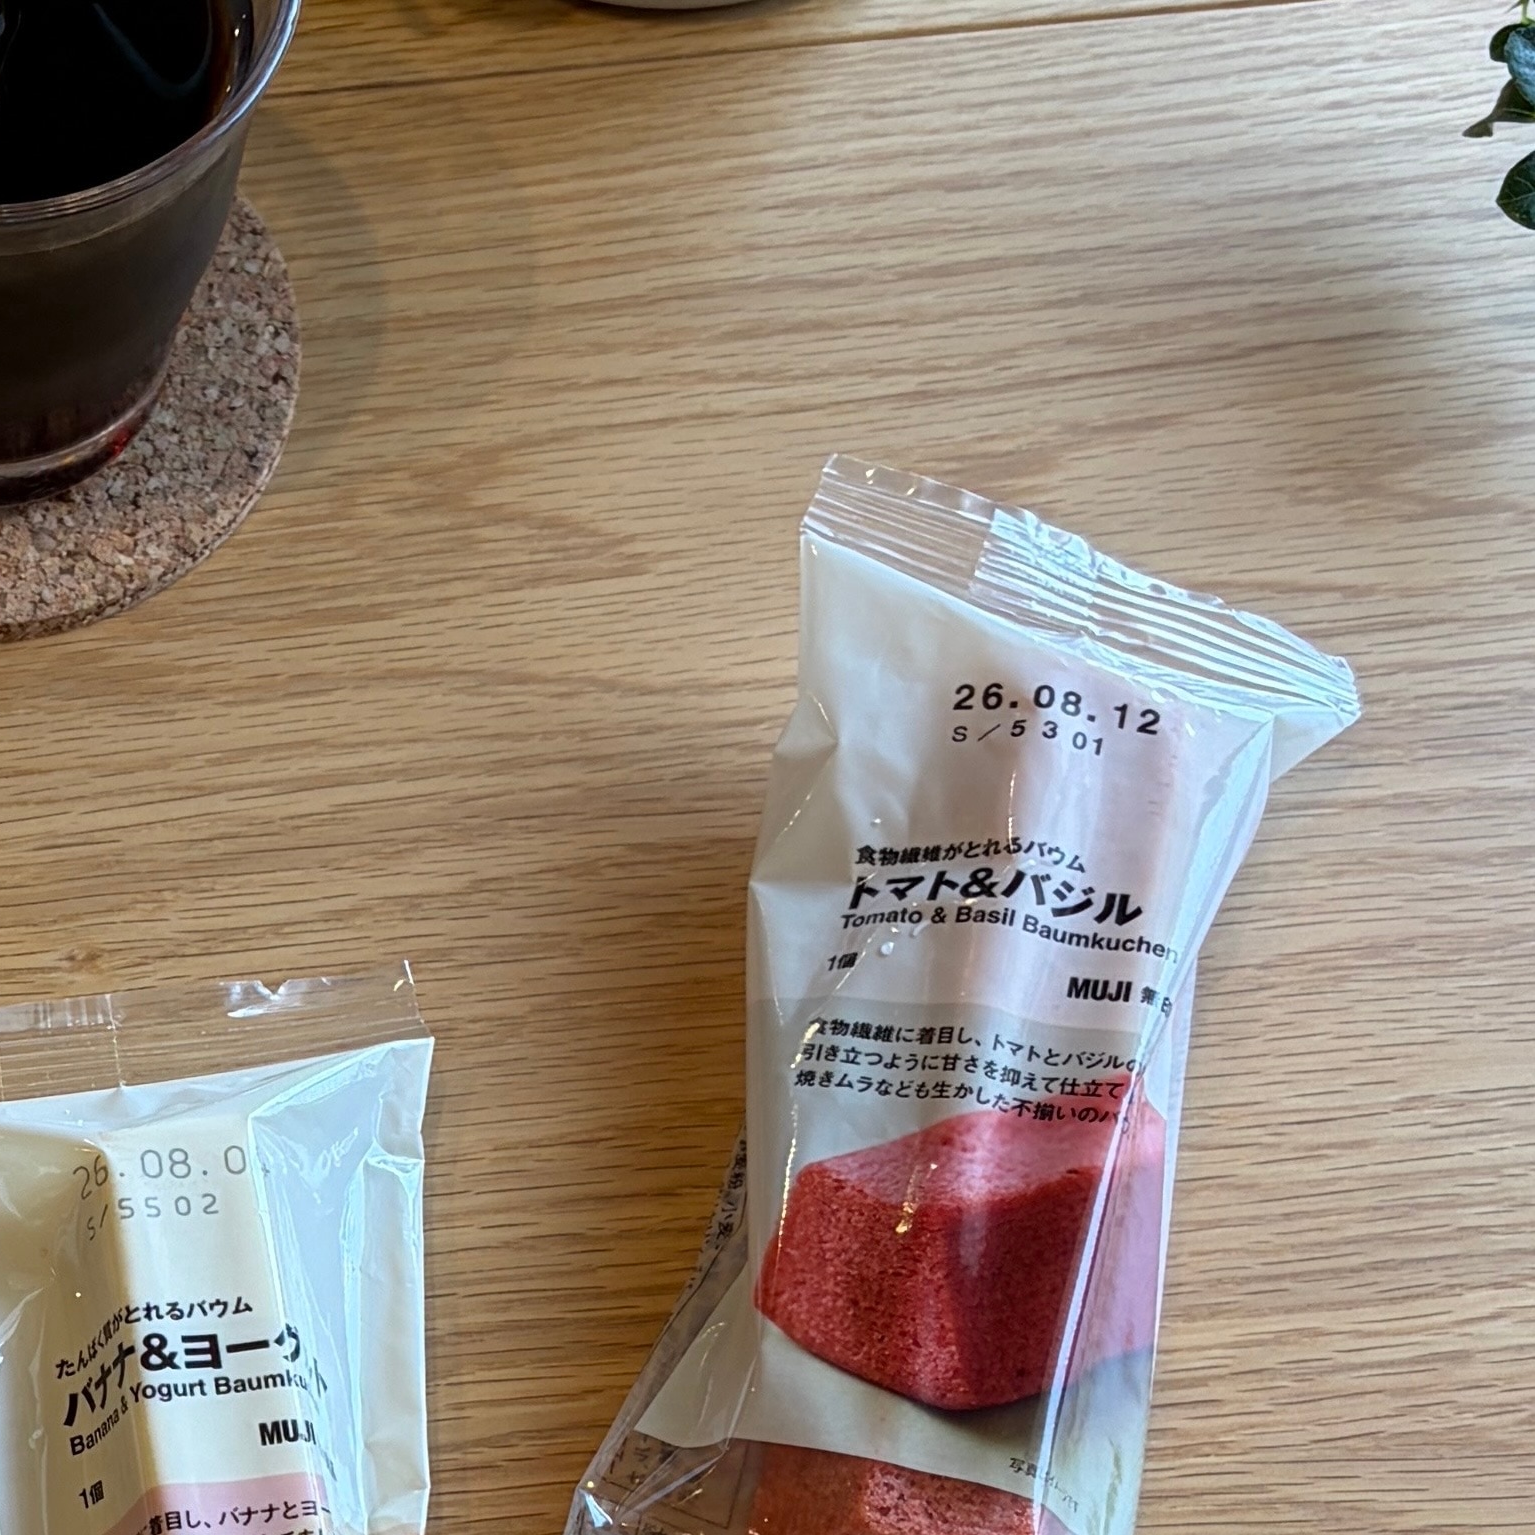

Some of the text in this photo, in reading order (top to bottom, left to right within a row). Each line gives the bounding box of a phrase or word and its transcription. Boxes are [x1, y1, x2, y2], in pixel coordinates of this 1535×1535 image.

[952, 683, 1162, 736] 26.08.12
[854, 836, 1087, 874] 食物繊維がとれるバウム
[847, 866, 1145, 928] トマト&バジル
[840, 904, 1179, 965] Tomato & Basil Baumkuchen
[1066, 976, 1133, 1003] MUJI
[73, 1144, 269, 1200] 26.08.0
[69, 1407, 120, 1456] Banana
[120, 1394, 129, 1415] &
[129, 1378, 207, 1403] Yogurt
[78, 1480, 105, 1510] 1個
